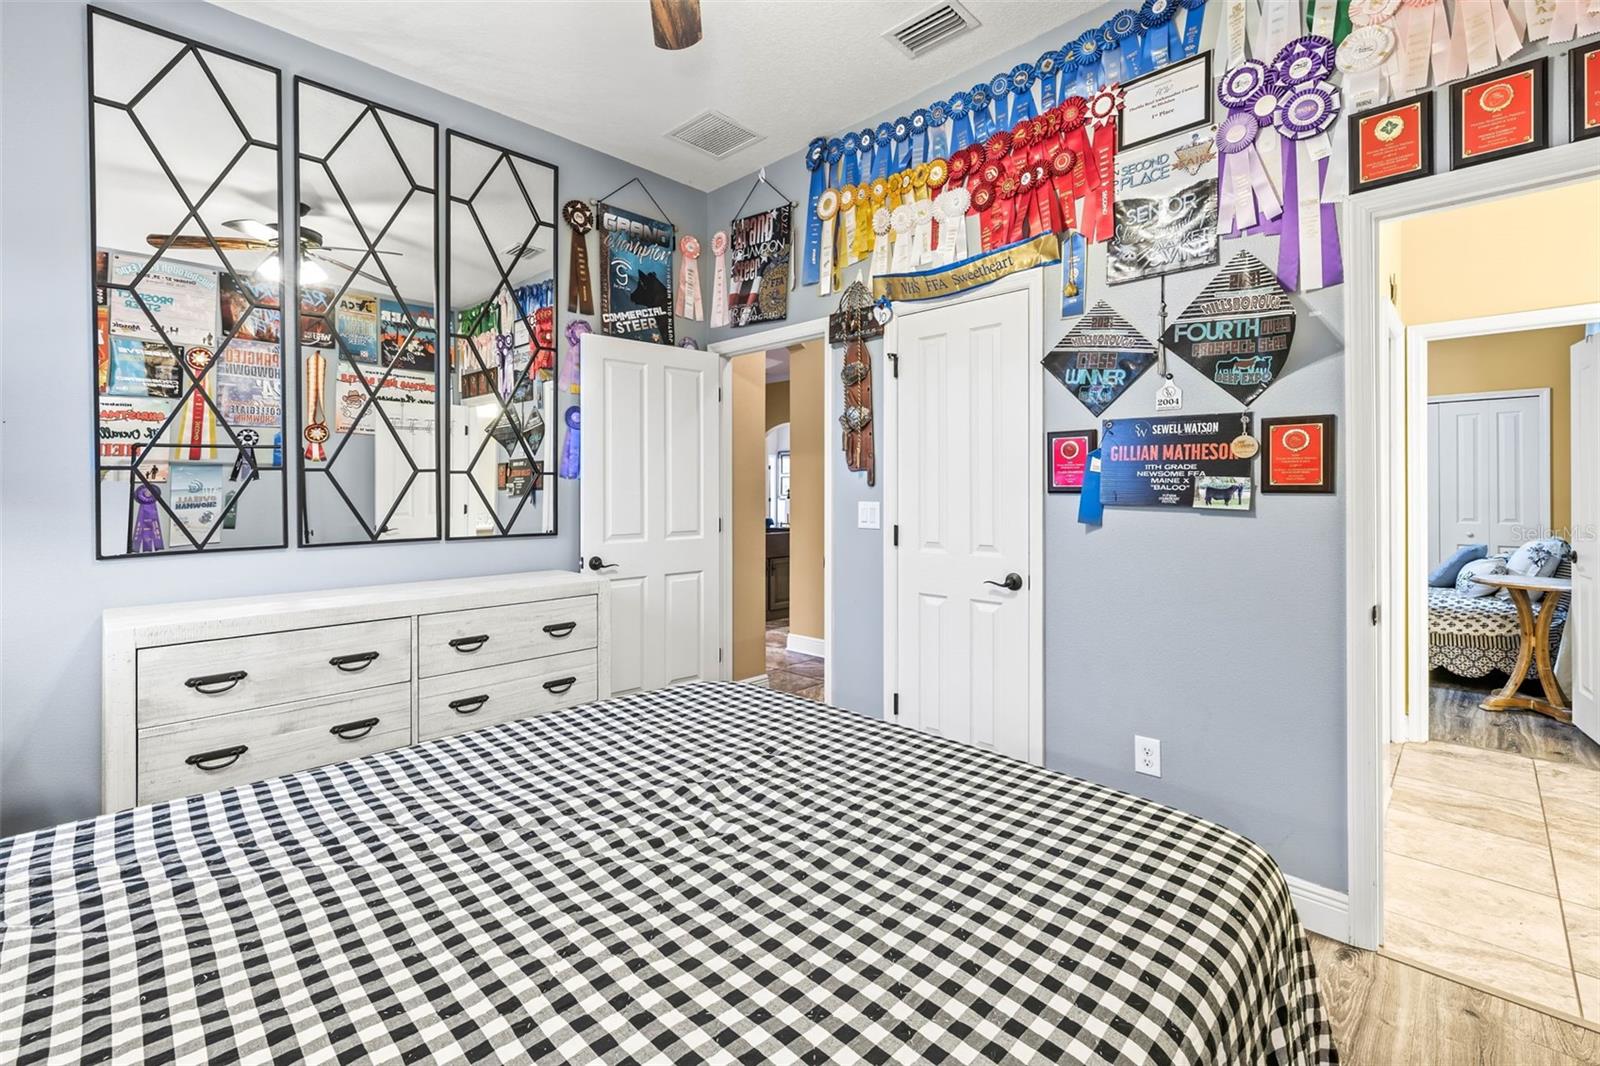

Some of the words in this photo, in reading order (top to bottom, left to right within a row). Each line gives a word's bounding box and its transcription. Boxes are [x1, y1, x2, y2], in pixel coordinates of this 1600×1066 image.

[1159, 108, 1175, 117] Place
[1121, 153, 1170, 176] SECOND
[1120, 165, 1170, 191] PLACE
[1126, 192, 1198, 225] SENOR
[603, 212, 669, 248] GRAND
[926, 278, 949, 293] FFA
[951, 255, 1014, 286] Sweetheart
[1201, 294, 1281, 315] HILLSBOROUGH
[602, 306, 667, 323] COMMERCIAL
[616, 317, 658, 334] STEER
[1174, 318, 1260, 344] FOURTH
[1065, 368, 1126, 386] WINNER
[1157, 397, 1179, 406] 2004
[1152, 423, 1182, 435] SEWELL
[1183, 421, 1219, 434] WATSON
[1110, 445, 1158, 462] GILLIAN
